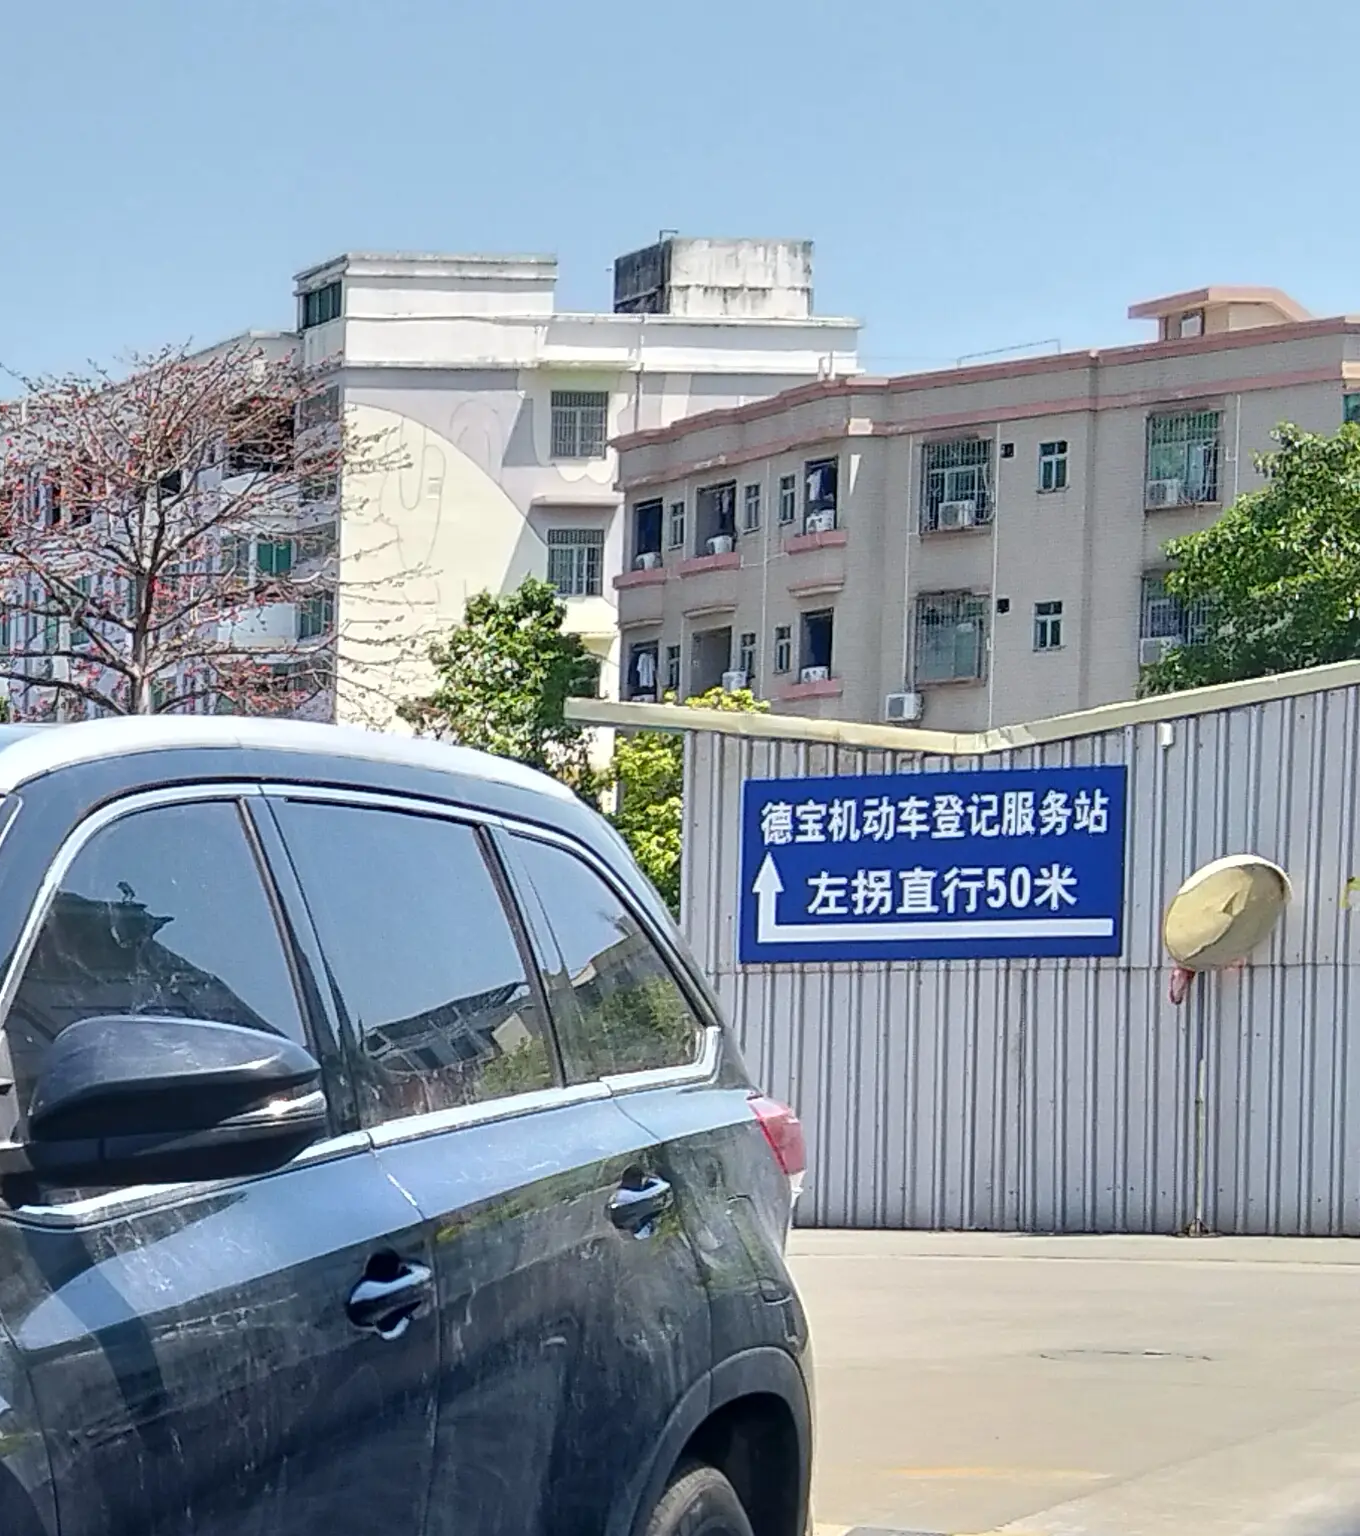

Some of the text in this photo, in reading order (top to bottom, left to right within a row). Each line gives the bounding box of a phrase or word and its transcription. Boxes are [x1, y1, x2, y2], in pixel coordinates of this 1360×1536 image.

[761, 789, 1109, 845] 德宝机动车登记服务站
[806, 863, 1079, 915] 左拐直行50米
